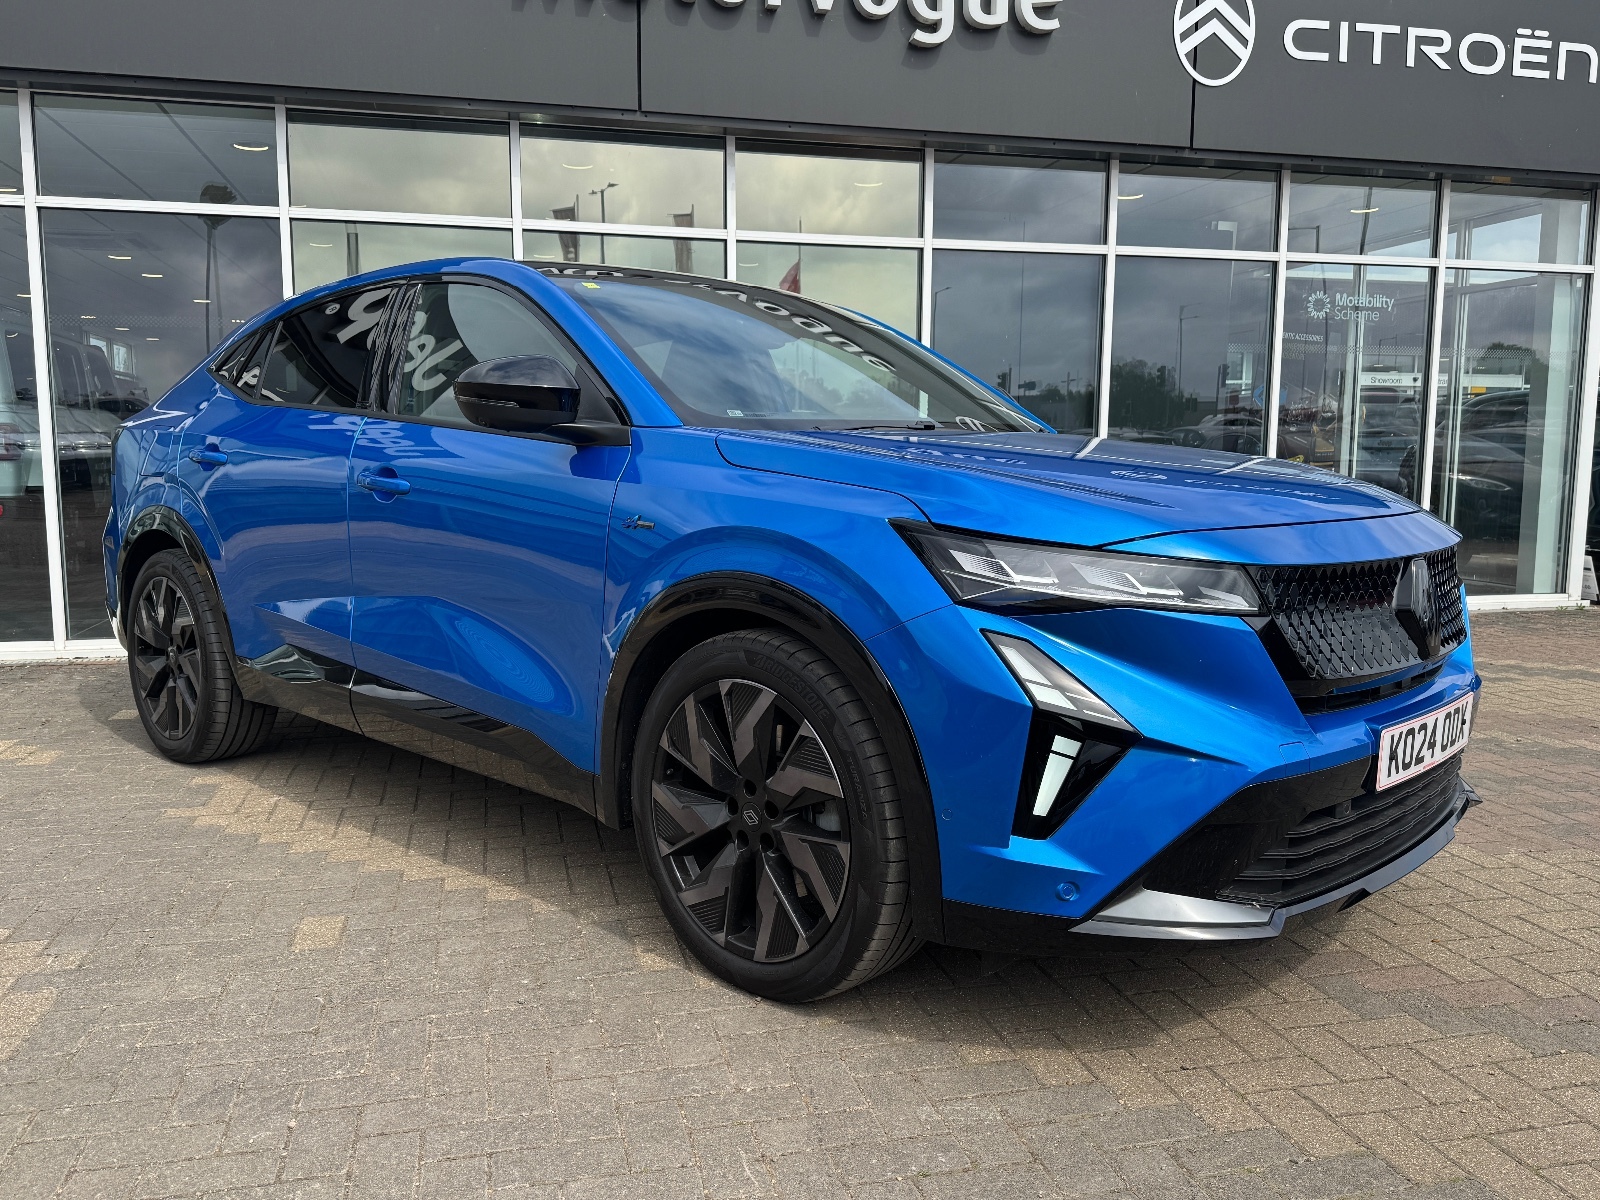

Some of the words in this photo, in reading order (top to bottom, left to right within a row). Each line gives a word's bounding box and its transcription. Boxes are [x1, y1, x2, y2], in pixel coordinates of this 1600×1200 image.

[1335, 292, 1395, 312] Motability
[1334, 306, 1380, 321] Scheme
[1370, 376, 1403, 385] Showroom
[753, 654, 830, 720] BRIDGESTONE
[1387, 716, 1439, 778] KO24
